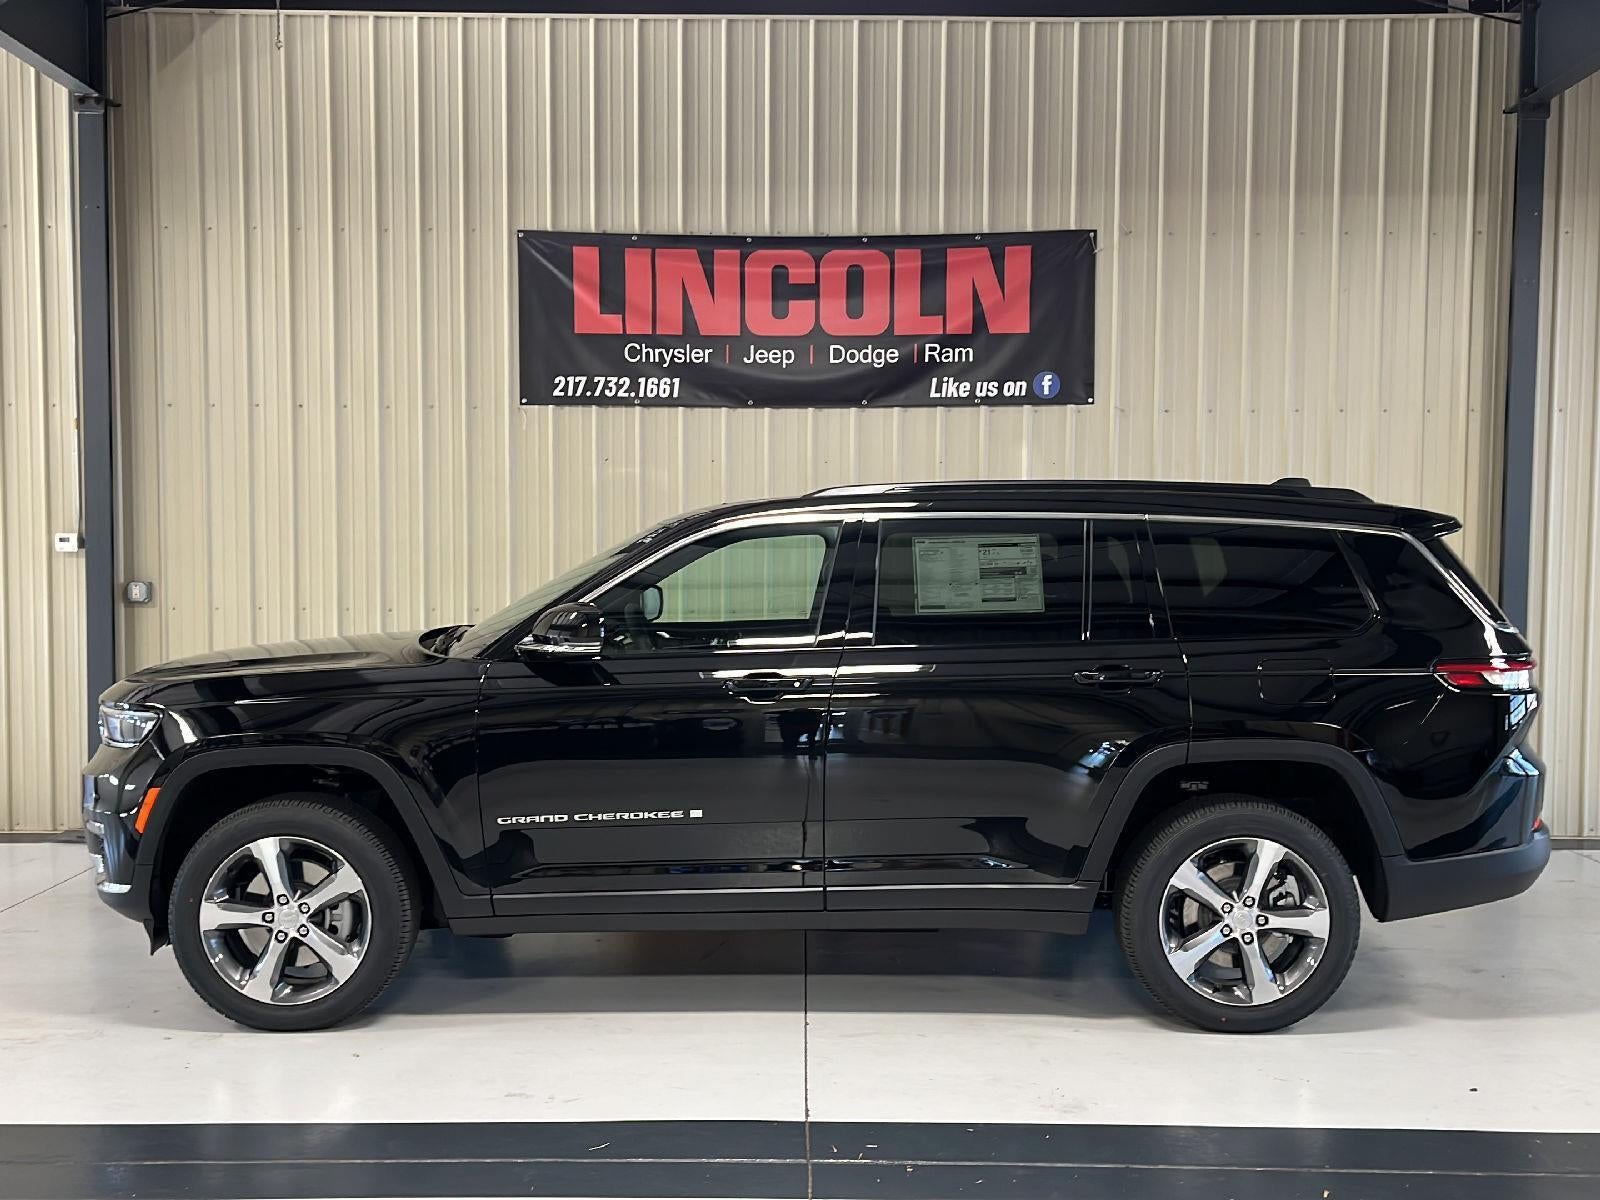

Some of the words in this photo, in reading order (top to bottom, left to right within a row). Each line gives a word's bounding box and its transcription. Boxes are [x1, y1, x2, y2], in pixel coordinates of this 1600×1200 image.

[573, 246, 1032, 335] LINCOLN
[623, 343, 713, 367] Chrysler
[743, 344, 795, 368] Jeep
[828, 344, 900, 368] Dodge
[924, 344, 974, 363] Ram
[552, 376, 680, 398] 217.732.1661
[930, 376, 971, 397] Like
[975, 381, 999, 397] us
[1002, 381, 1027, 397] on
[496, 815, 569, 825] GRAND
[573, 810, 685, 821] CHEROKEE
